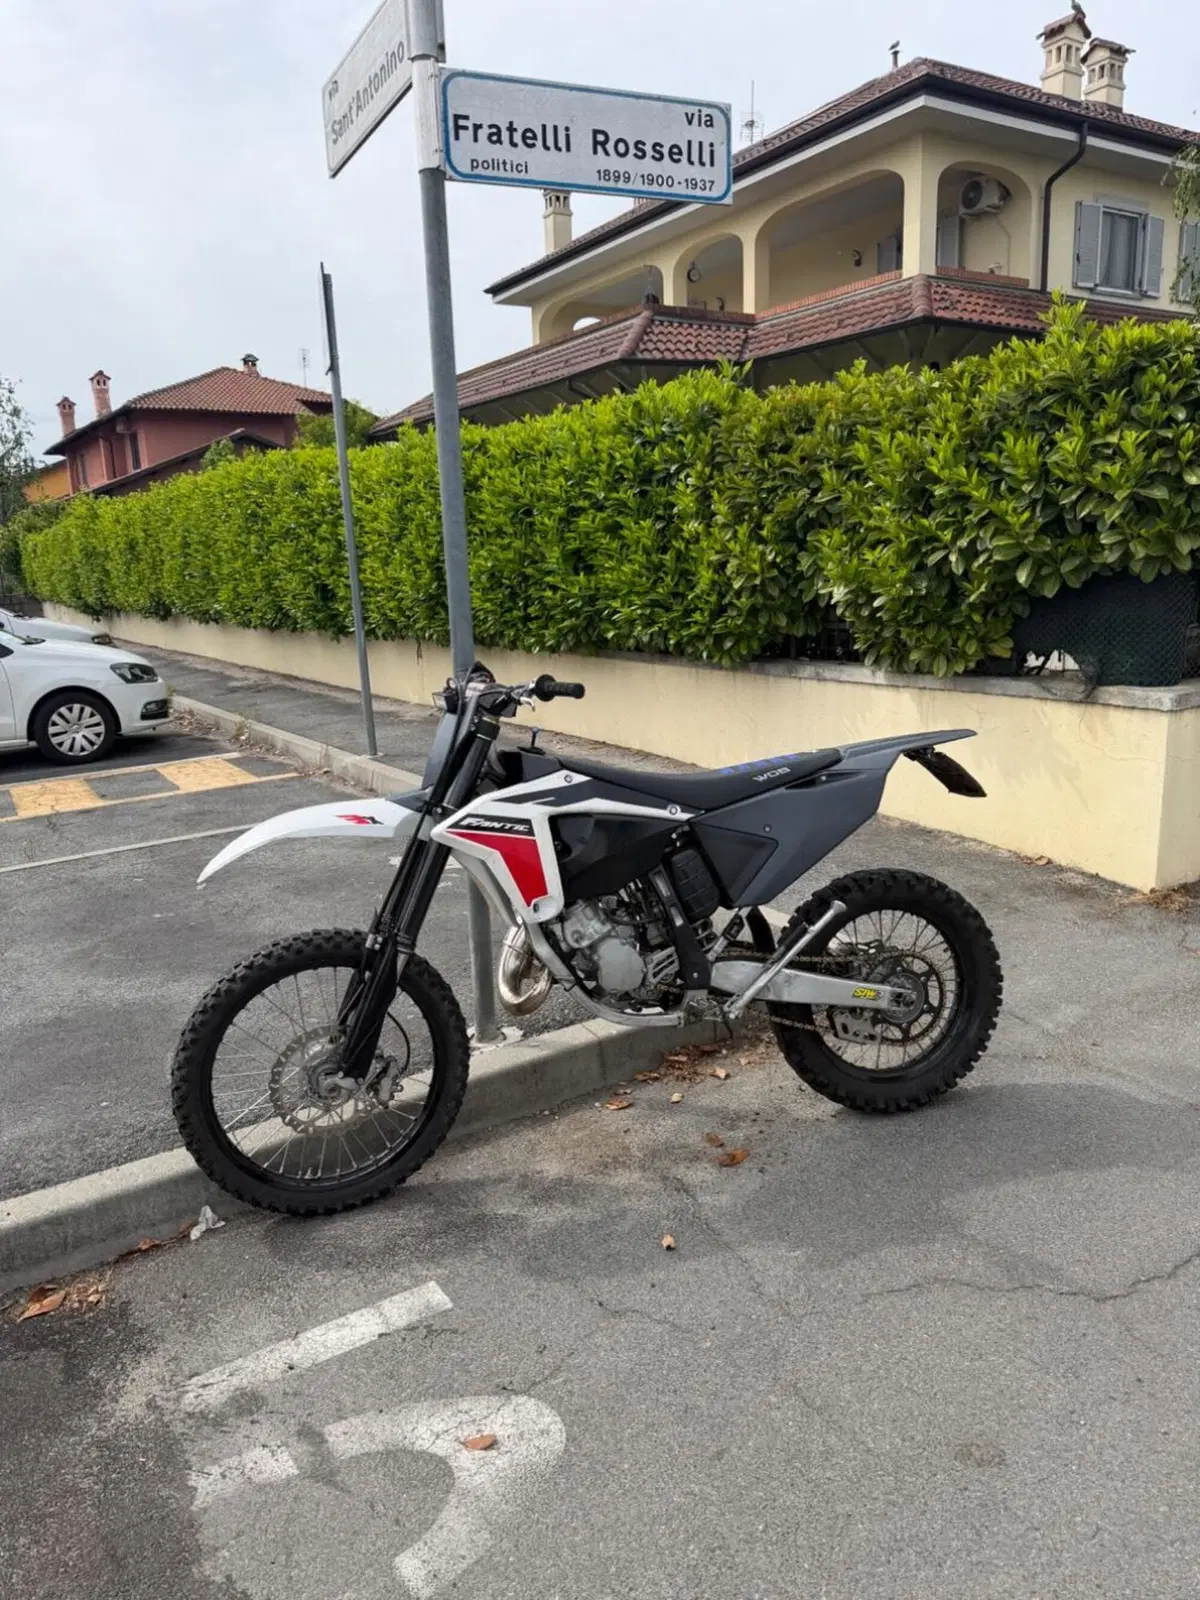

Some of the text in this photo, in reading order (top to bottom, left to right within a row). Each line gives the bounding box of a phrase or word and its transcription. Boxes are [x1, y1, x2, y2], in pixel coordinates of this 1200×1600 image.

[331, 40, 405, 145] Sant'Antonino
[684, 108, 714, 128] via
[452, 113, 715, 167] Fratelli Rosselli
[470, 158, 715, 191] politici 1899/1900-1937
[459, 817, 530, 832] FANTIC
